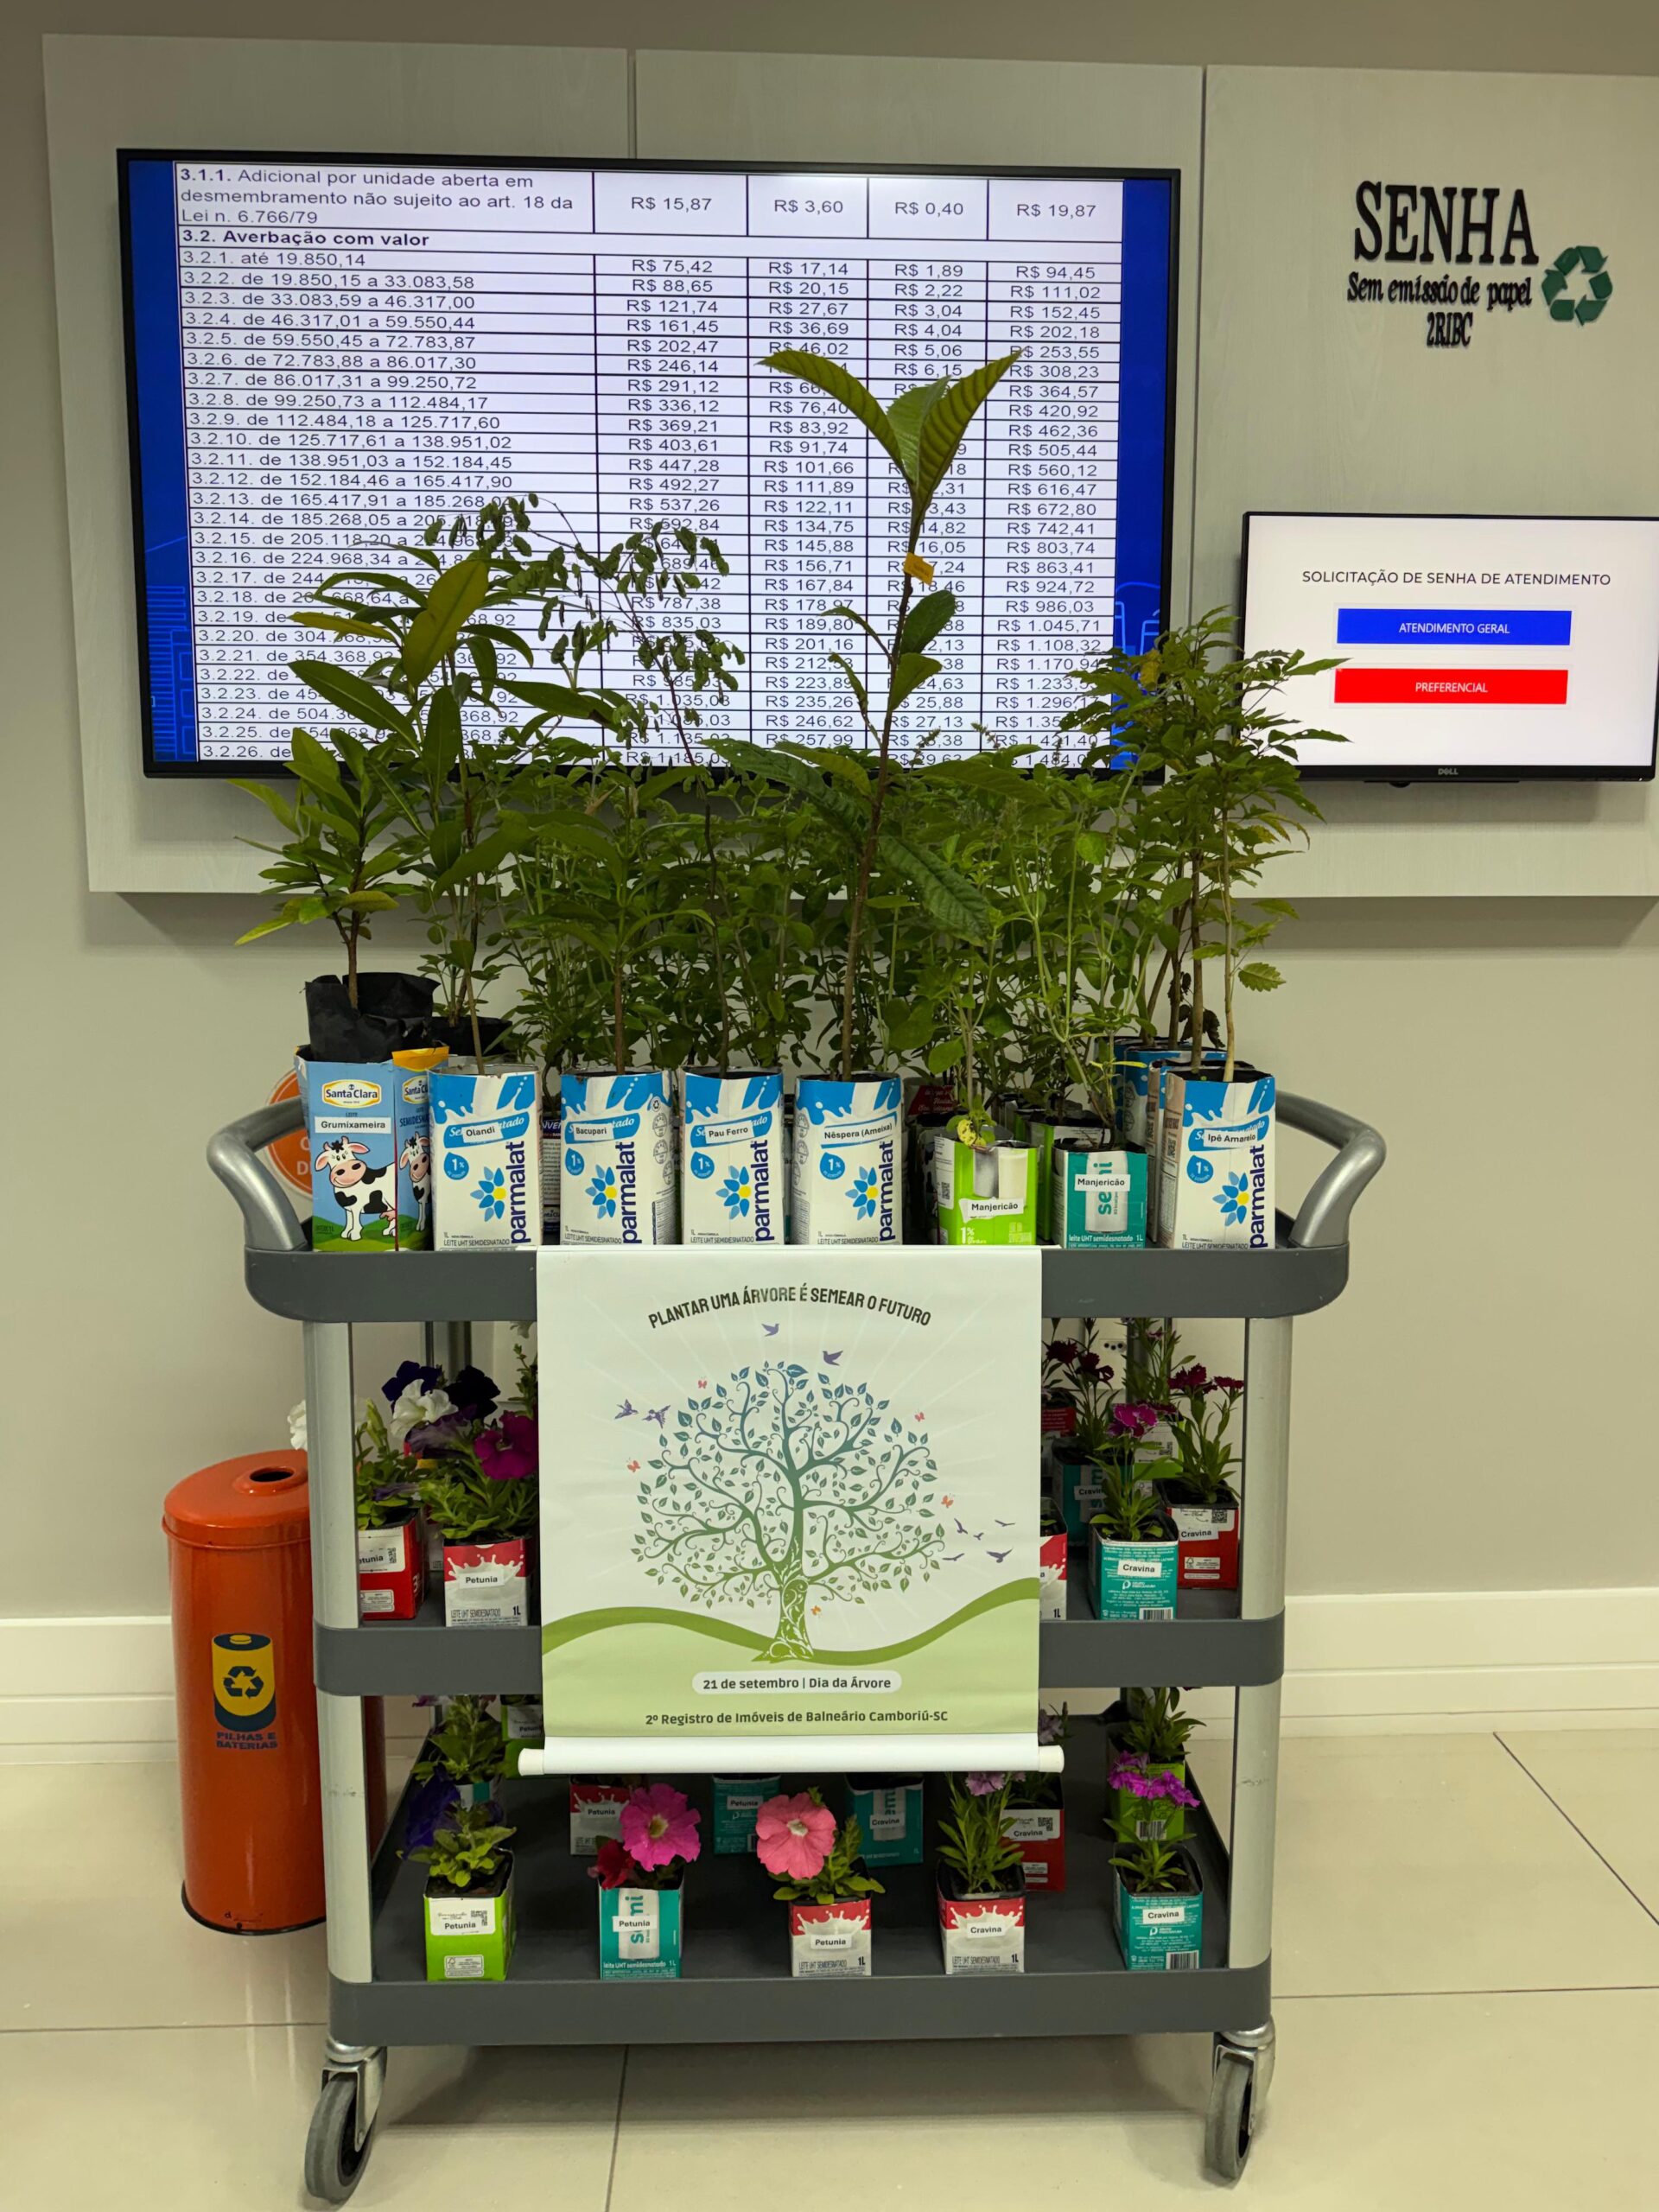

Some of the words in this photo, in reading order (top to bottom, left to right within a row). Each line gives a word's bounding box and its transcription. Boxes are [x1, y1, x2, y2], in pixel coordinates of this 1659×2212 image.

[180, 168, 232, 181] 3.1.1.
[238, 169, 321, 183] Adicional
[327, 174, 355, 187] por
[364, 173, 435, 186] unidade
[442, 175, 499, 188] aberta
[505, 178, 533, 188] em
[181, 190, 347, 205] desmembramento
[353, 193, 387, 206] não
[394, 194, 453, 210] sujeito
[459, 198, 481, 207] ao
[486, 196, 516, 208] art.
[524, 196, 544, 209] 18
[550, 197, 574, 210] da
[632, 197, 657, 211] R$
[663, 198, 713, 213] 15,87
[774, 200, 799, 213] R$
[804, 200, 844, 215] 3,60
[182, 210, 209, 222] Lei
[214, 213, 232, 223] n.
[238, 211, 318, 224] 6.766/79
[894, 202, 919, 216] R$
[925, 202, 964, 218] 0,40
[1016, 204, 1041, 218] R$
[1048, 205, 1096, 219] 19,87
[1354, 180, 1539, 265] SENHA
[183, 229, 216, 243] 3.2.
[223, 231, 327, 246] Averbação
[334, 235, 374, 245] com
[381, 233, 429, 246] valor
[183, 251, 234, 264] 3.2.1.
[241, 252, 269, 264] até
[276, 252, 365, 268] 19.850,14
[632, 259, 657, 272] R$
[663, 260, 713, 275] 75,42
[768, 262, 793, 275] R$
[800, 262, 849, 277] 17,14
[894, 264, 918, 276] R$
[926, 264, 963, 279] 1,89
[1016, 265, 1040, 278] R$
[1046, 266, 1096, 281] 94,45
[184, 271, 235, 284] 3.2.2.
[241, 272, 264, 285] de
[271, 273, 361, 288] 19.850,15
[367, 276, 378, 288] a
[385, 275, 474, 289] 33.083,58
[632, 279, 657, 292] R$
[663, 280, 713, 295] 88,65
[1010, 286, 1035, 299] R$
[1042, 286, 1101, 301] 111,02
[1347, 271, 1383, 301] Sem
[1460, 276, 1480, 303] de
[1486, 276, 1532, 311] papel
[1427, 311, 1473, 346] 2RIBC
[193, 472, 256, 485] 3.2.12.
[260, 473, 283, 486] de
[289, 474, 390, 489] 152.184,46
[395, 477, 406, 487] a
[414, 474, 512, 490] 165.417,90
[1301, 569, 1399, 586] SOLICITAÇÃO
[1403, 571, 1423, 584] DE
[1427, 571, 1477, 584] SENHA
[1480, 572, 1502, 585] DE
[1504, 572, 1611, 586] ATENDIMENTO
[998, 619, 1021, 632] R$
[1027, 620, 1100, 634] 1.045,71
[1399, 621, 1475, 634] ATENDIMENTO
[1477, 622, 1510, 635] GERAL
[1414, 681, 1488, 694] PREFERENCIAL
[1438, 766, 1459, 776] DELL
[326, 1089, 352, 1098] Santa
[353, 1090, 378, 1099] Clara
[321, 1121, 385, 1129] Grumixameira
[466, 1126, 495, 1136] Olandi
[575, 1125, 607, 1135] Bacupari
[709, 1128, 723, 1138] Pau
[725, 1127, 748, 1137] Ferro
[861, 1122, 893, 1137] (Ameixa)
[1207, 1133, 1223, 1143] Ipê
[1077, 1178, 1126, 1187] Manjericão
[505, 1141, 531, 1243] parmalat
[615, 1141, 642, 1244] parmalat
[750, 1140, 775, 1242] parmalat
[879, 1140, 896, 1242] parmalat
[1249, 1144, 1268, 1249] parmalat
[971, 1202, 1019, 1212] Manjericão
[648, 1298, 709, 1328] PLANTAR
[710, 1291, 740, 1310] UMA
[743, 1286, 796, 1305] ÁRVORE
[799, 1282, 808, 1302] É
[810, 1287, 865, 1307] SEMEAR
[867, 1295, 877, 1310] O
[878, 1298, 931, 1326] FUTURO
[1180, 1529, 1211, 1539] Cravina
[359, 1554, 384, 1565] etunia
[1122, 1563, 1155, 1573] Cravina
[465, 1575, 499, 1584] Petunia
[512, 1605, 521, 1616] 1L
[1053, 1607, 1061, 1618] 1L
[703, 1679, 718, 1690] 21
[721, 1679, 736, 1689] de
[739, 1678, 799, 1689] setembro
[809, 1677, 829, 1688] Dia
[832, 1677, 848, 1688] da
[850, 1675, 891, 1688] Árvore
[645, 1714, 658, 1725] 2º
[661, 1713, 714, 1726] Registro
[716, 1713, 732, 1723] de
[735, 1711, 784, 1723] Imóveis
[787, 1711, 803, 1722] de
[806, 1710, 866, 1722] Balneário
[869, 1710, 948, 1722] Camboriú-SC
[216, 1731, 263, 1740] PILHAS
[268, 1732, 276, 1740] E
[216, 1740, 277, 1751] BATERIAS
[1014, 1828, 1043, 1837] Cravina
[1147, 1910, 1179, 1919] Cravina
[444, 1921, 476, 1930] Petunia
[858, 1955, 866, 1966] 1L
[1011, 1953, 1019, 1963] 1L
